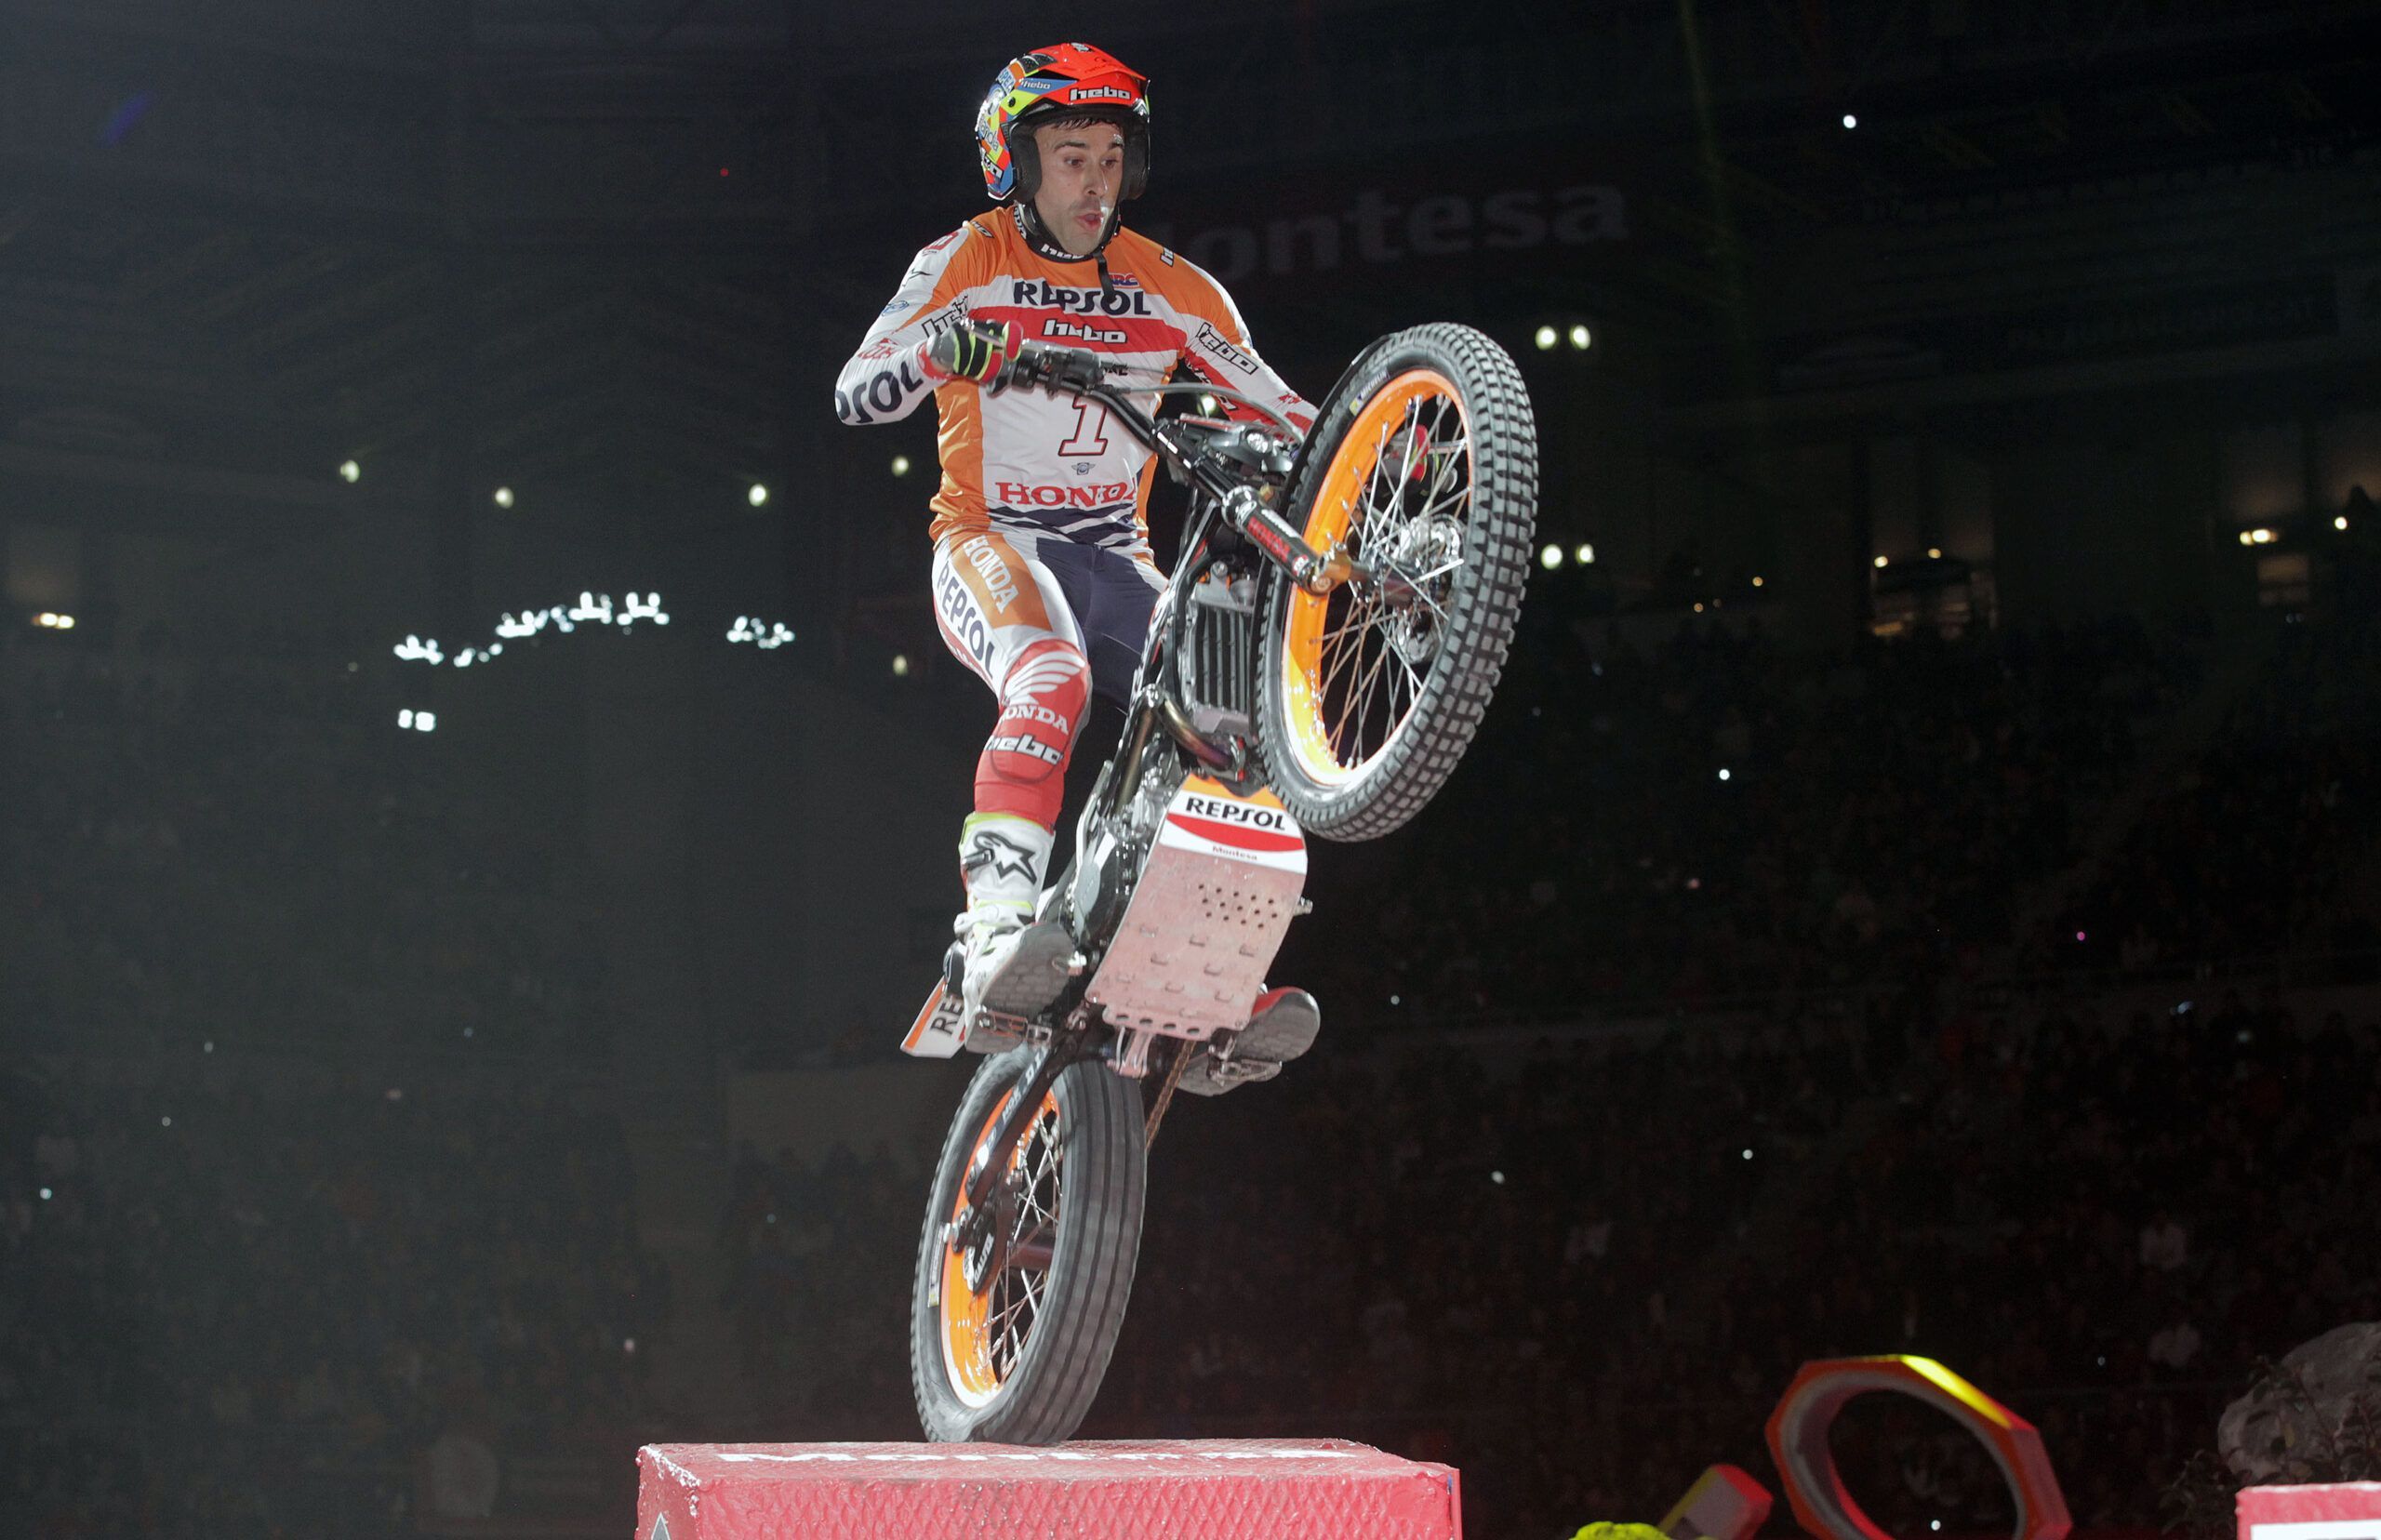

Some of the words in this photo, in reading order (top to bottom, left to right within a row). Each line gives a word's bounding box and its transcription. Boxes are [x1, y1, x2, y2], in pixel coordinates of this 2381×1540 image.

[1070, 86, 1131, 102] hebo
[1156, 185, 1629, 285] ontesa
[1013, 280, 1152, 317] REPSOL
[1057, 393, 1109, 457] 1
[963, 534, 1020, 615] HONDA
[1185, 796, 1286, 831] REPSOL
[1212, 844, 1257, 861] Montesa
